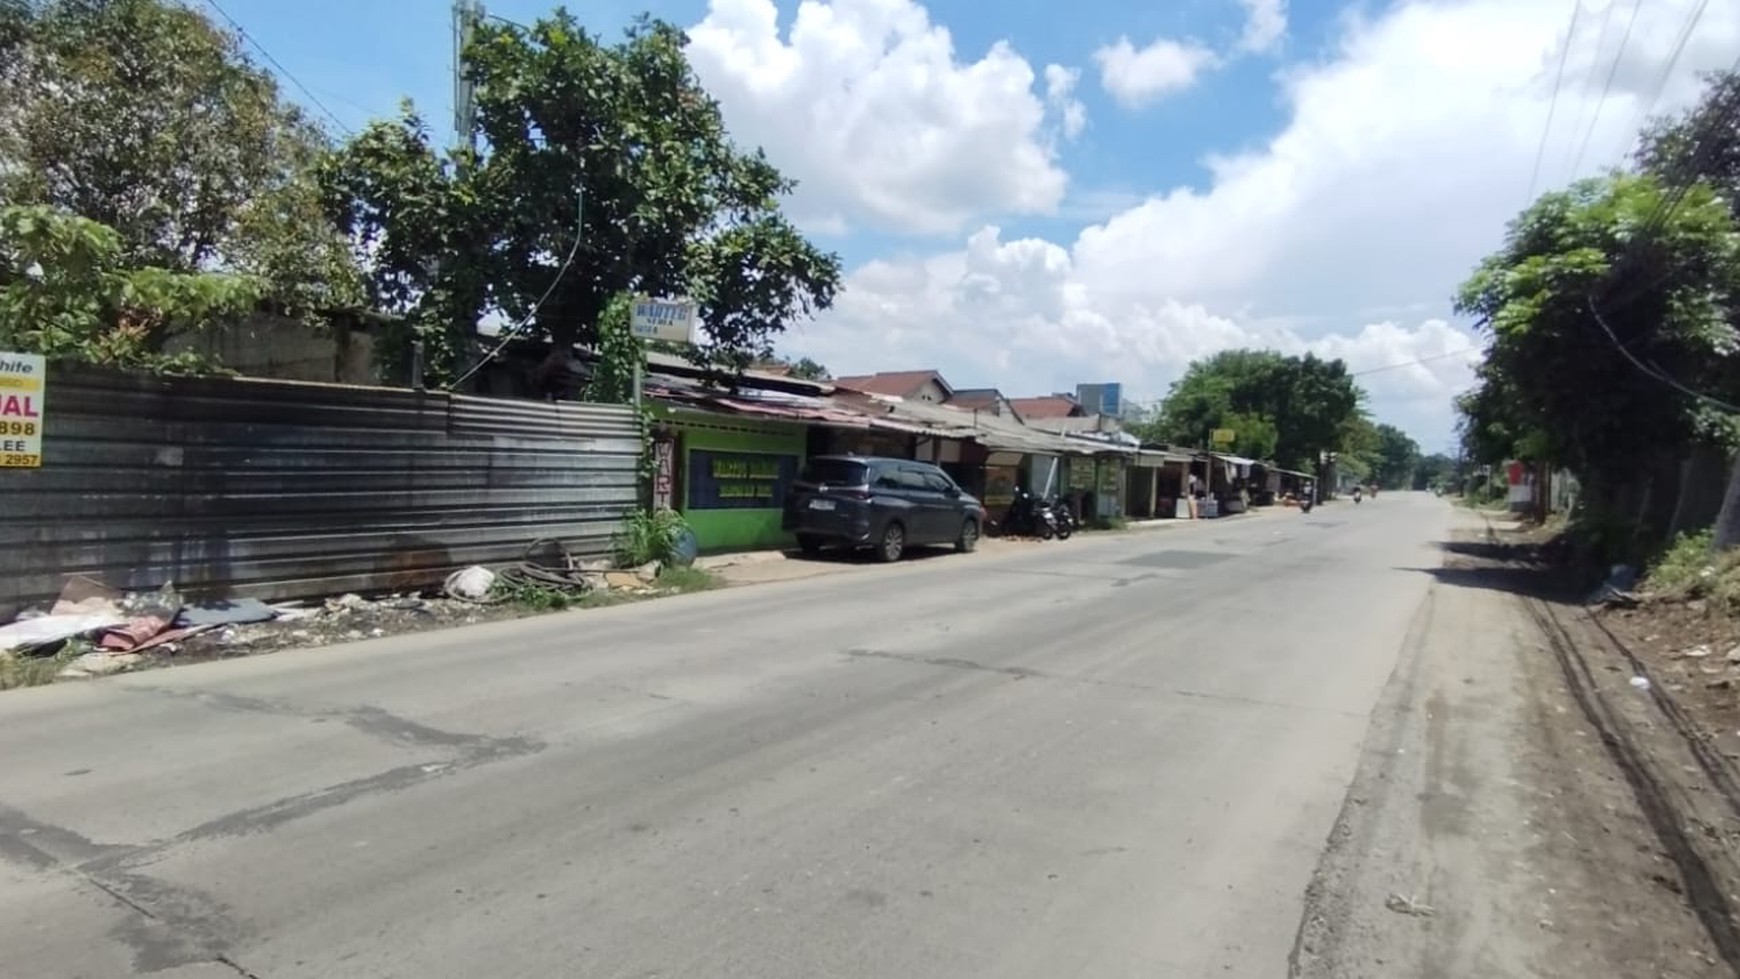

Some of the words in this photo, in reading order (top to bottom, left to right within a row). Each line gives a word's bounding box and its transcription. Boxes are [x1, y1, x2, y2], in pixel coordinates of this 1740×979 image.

[0, 394, 39, 417] AL
[0, 440, 26, 452] EE
[6, 454, 38, 465] 2957
